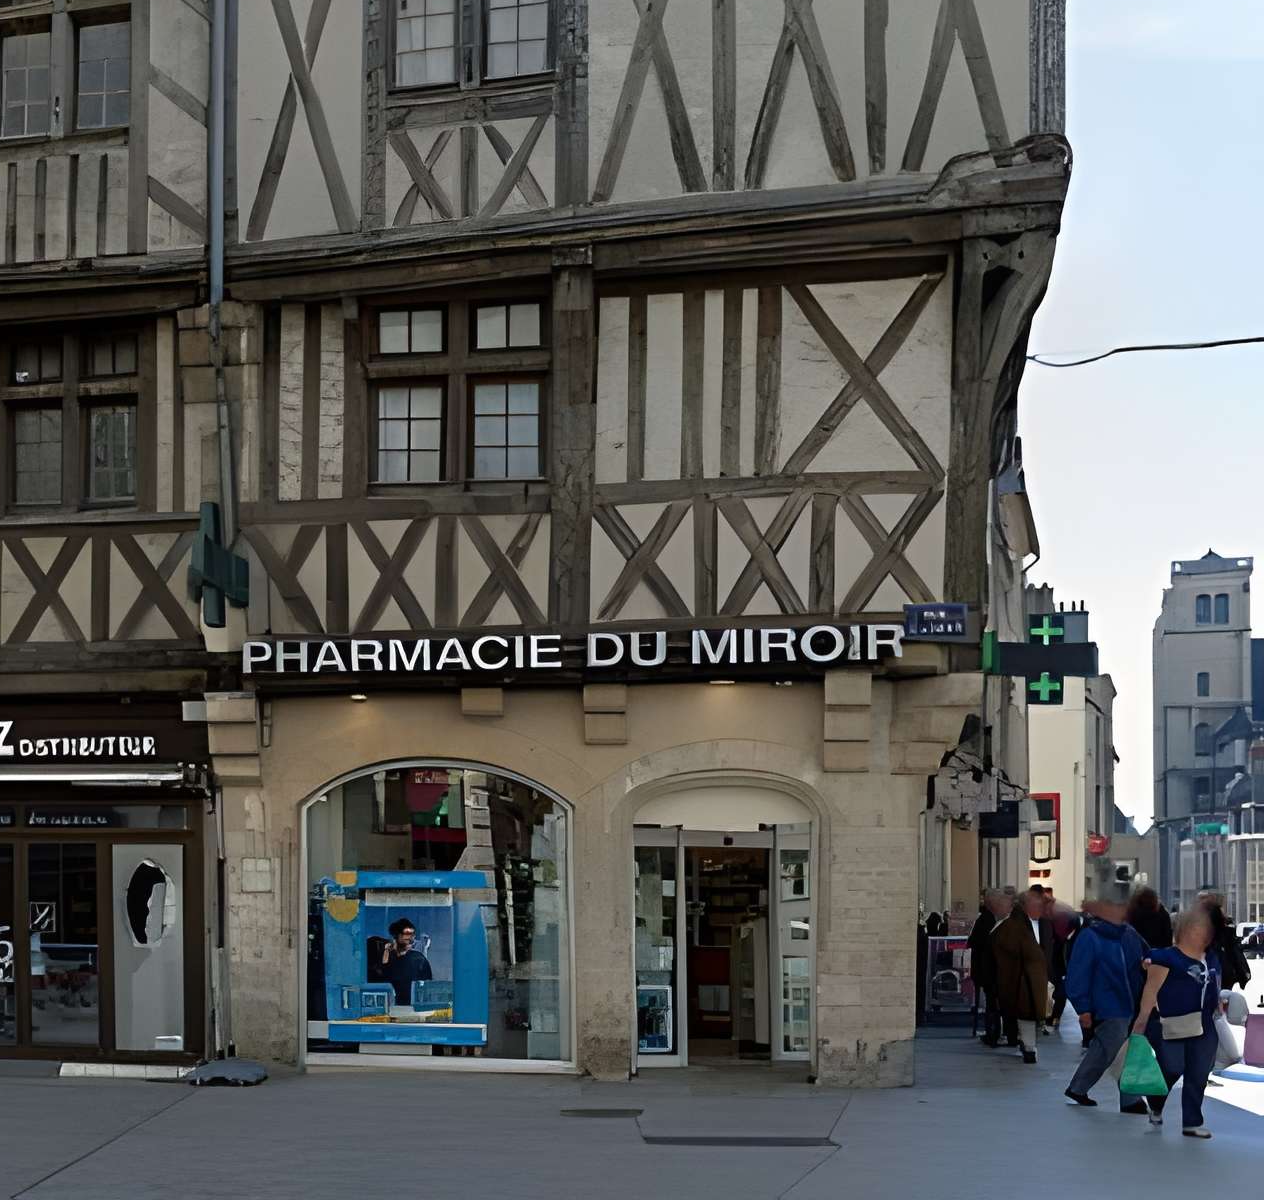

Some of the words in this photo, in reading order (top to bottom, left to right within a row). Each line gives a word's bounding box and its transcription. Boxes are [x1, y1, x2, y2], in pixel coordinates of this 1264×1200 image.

[242, 633, 563, 674] PHARMACIE
[586, 631, 667, 668] DU
[691, 624, 905, 665] MIROIR
